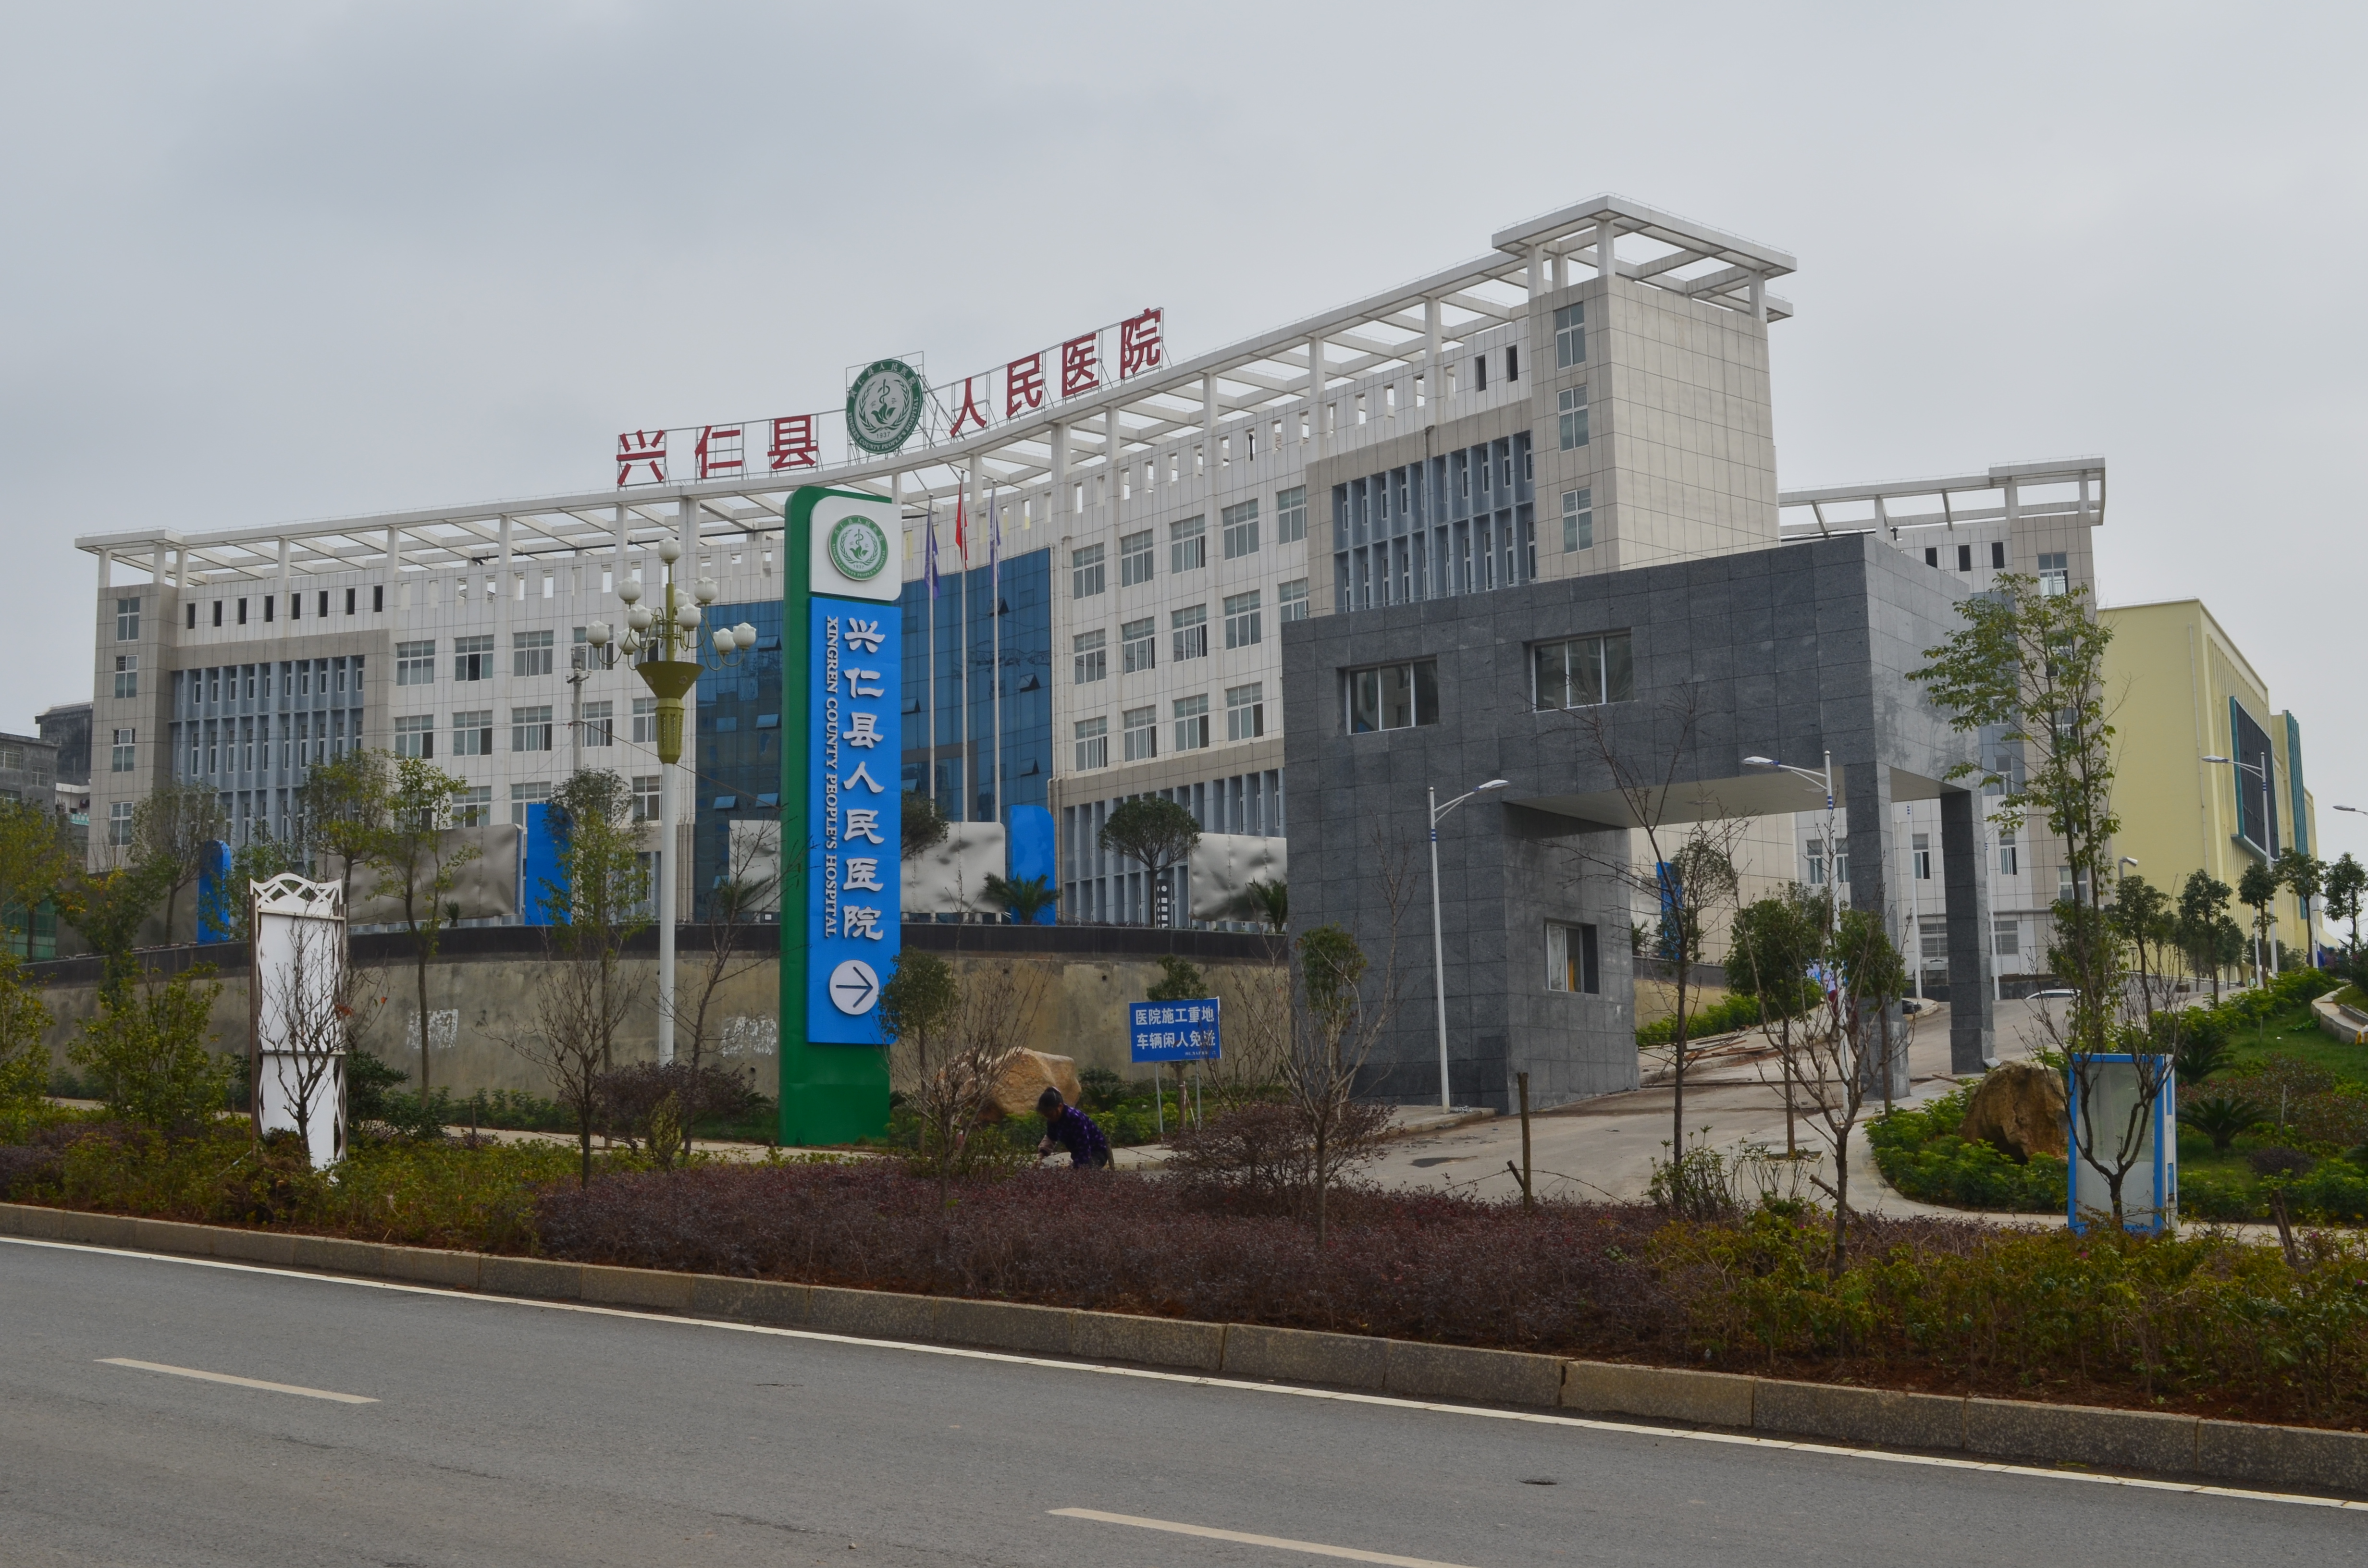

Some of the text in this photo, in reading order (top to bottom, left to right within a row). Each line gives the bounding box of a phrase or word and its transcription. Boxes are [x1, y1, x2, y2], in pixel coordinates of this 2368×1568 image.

[616, 307, 1160, 486] 兴仁县 人民医院
[847, 396, 918, 450] XINGREN COUNTY PEOPLE'S HOSPITAL
[825, 615, 838, 938] XINGREN COUNTY PEOPLE'S HOSPITAL
[843, 617, 885, 940] 兴仁县人民医院
[1135, 1005, 1215, 1025] 医院施工重地
